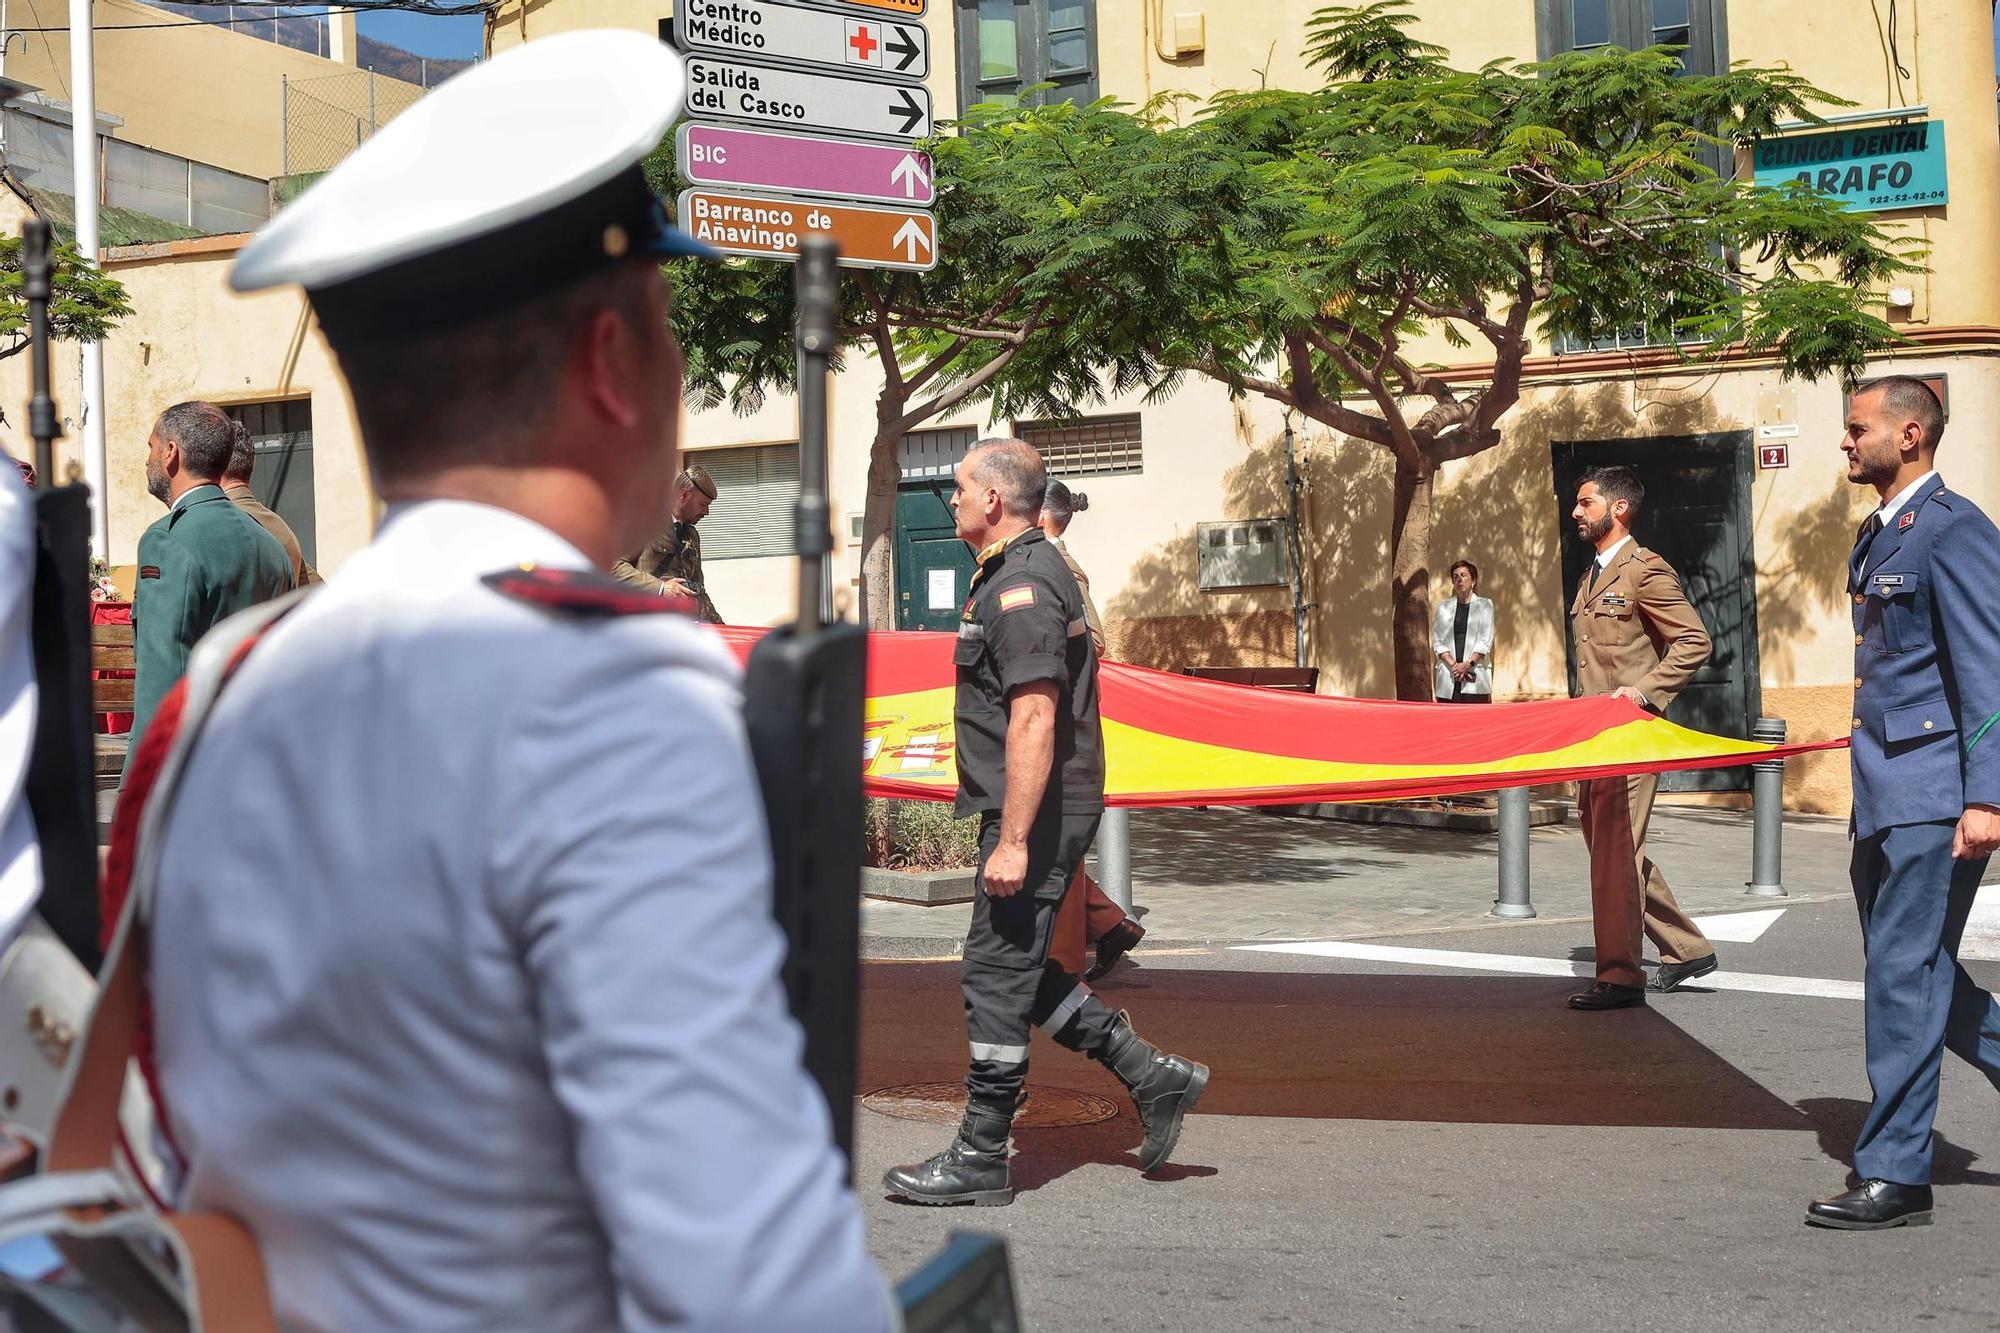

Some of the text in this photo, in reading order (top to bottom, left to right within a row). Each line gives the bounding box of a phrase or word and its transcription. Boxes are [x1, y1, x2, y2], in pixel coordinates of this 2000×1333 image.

[689, 0, 762, 26] Centro
[689, 18, 765, 48] Médico
[692, 64, 760, 91] Salida
[692, 88, 805, 119] del Casco
[692, 143, 727, 164] BIC
[1852, 130, 1928, 157] DENTAL
[695, 198, 833, 230] Barranco de
[697, 220, 798, 250] Añavingo
[1770, 449, 1778, 464] 2
